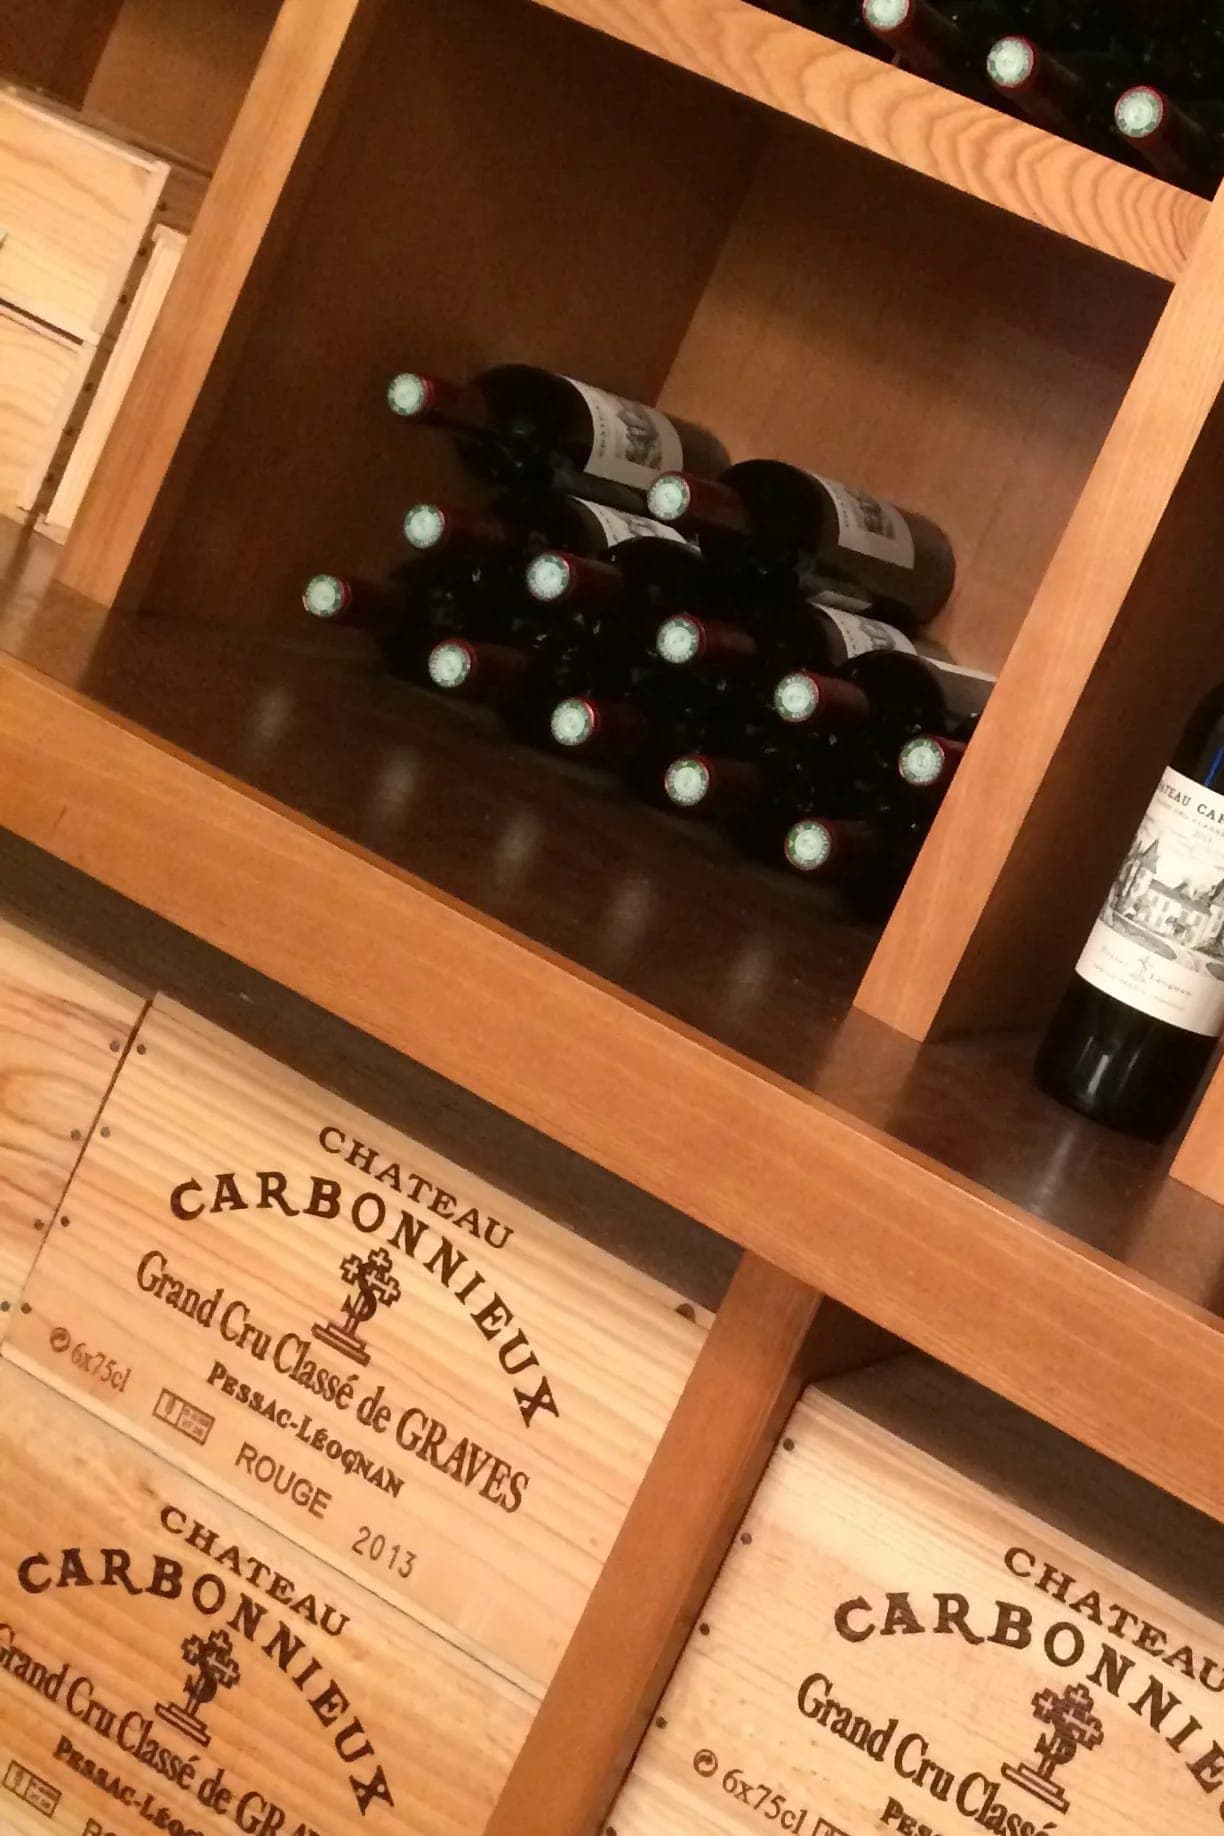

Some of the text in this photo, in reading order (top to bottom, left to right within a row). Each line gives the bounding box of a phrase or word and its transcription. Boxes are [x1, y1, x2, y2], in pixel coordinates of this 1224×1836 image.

[319, 1126, 514, 1250] CHATEAU
[170, 1171, 560, 1428] CARBONNIEUX
[71, 1342, 132, 1392] 6x75cl
[137, 1250, 530, 1513] Grand Cru Classé de GRAVES
[234, 1442, 332, 1519] ROUGE
[159, 1505, 350, 1638] CHATEAU
[352, 1526, 417, 1578] 2013
[18, 1548, 394, 1816] CARBONNIEUX
[66, 1676, 118, 1740] Cru
[116, 1711, 200, 1790] Classé
[198, 1768, 232, 1814] de
[797, 1672, 898, 1761] Grand
[894, 1733, 955, 1802] Cru
[721, 1769, 808, 1834] 6x75cl
